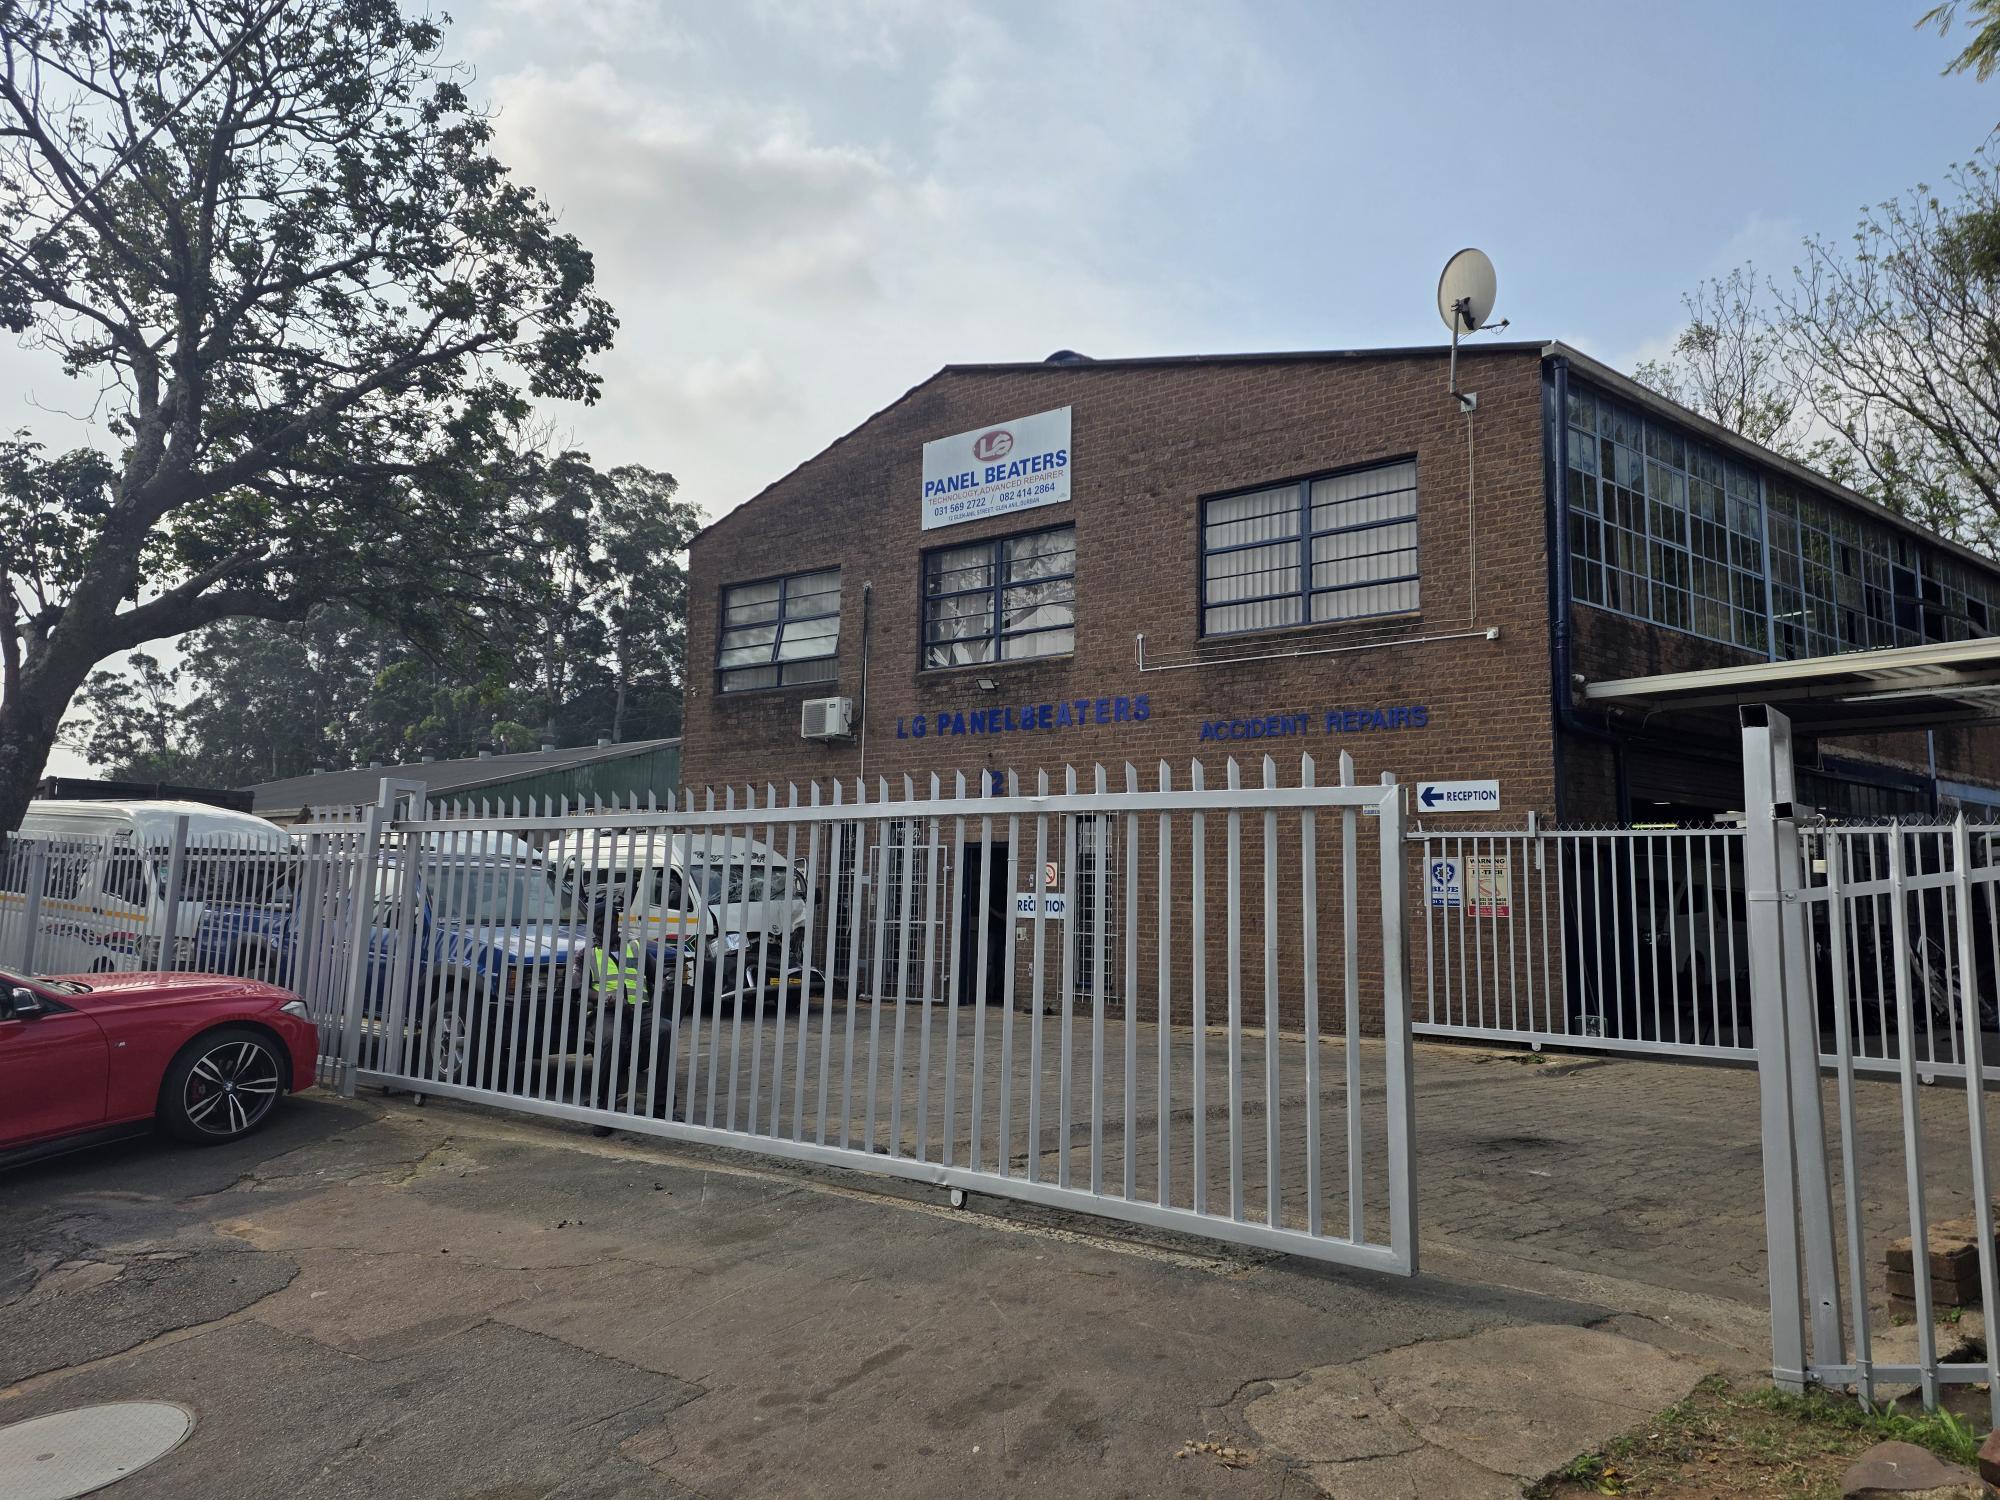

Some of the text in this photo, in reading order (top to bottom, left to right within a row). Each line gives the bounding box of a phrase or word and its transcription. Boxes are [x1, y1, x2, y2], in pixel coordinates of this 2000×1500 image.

[924, 450, 1068, 498] PANEL BEATERS
[1023, 469, 1064, 485] REPAIRER
[935, 505, 948, 517] 031
[950, 501, 965, 514] 569
[967, 497, 986, 510] 2722
[999, 490, 1015, 503] 082
[1017, 487, 1032, 499] 414
[1034, 481, 1056, 496] 2864
[896, 694, 1150, 740] LG PANELBEATERS
[1200, 705, 1430, 742] ACCIDENT REPAIRS
[1446, 790, 1497, 802] RECEPTION
[1017, 900, 1065, 913] RECTION
